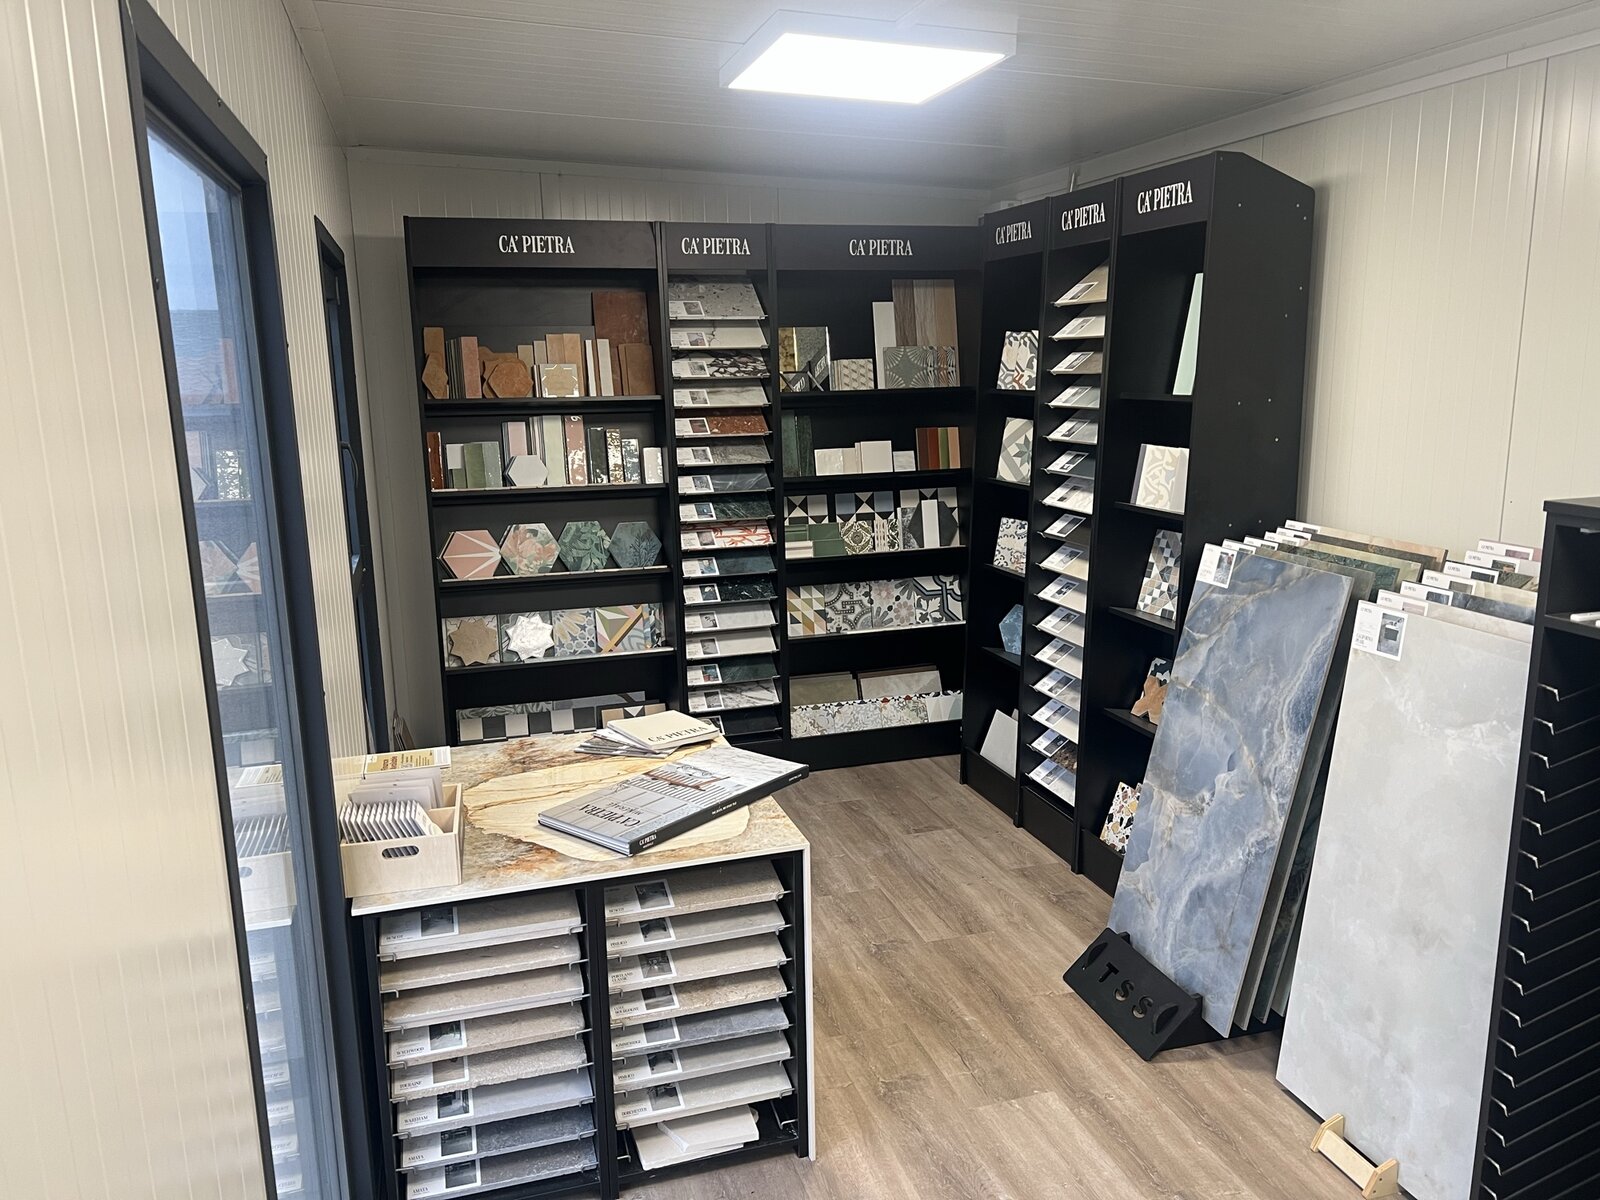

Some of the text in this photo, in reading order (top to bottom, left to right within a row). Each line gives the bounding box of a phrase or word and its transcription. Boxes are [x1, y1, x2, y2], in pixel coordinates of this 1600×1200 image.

[1153, 180, 1193, 211] PIETRA
[1074, 202, 1106, 228] PIETRA
[1006, 220, 1032, 243] PIETRA
[498, 234, 575, 254] CA' PIETRA
[681, 236, 750, 255] CA' PIETRA
[849, 238, 913, 256] CA' PIETRA
[665, 726, 708, 739] PIETRA
[579, 804, 625, 822] PIETRA
